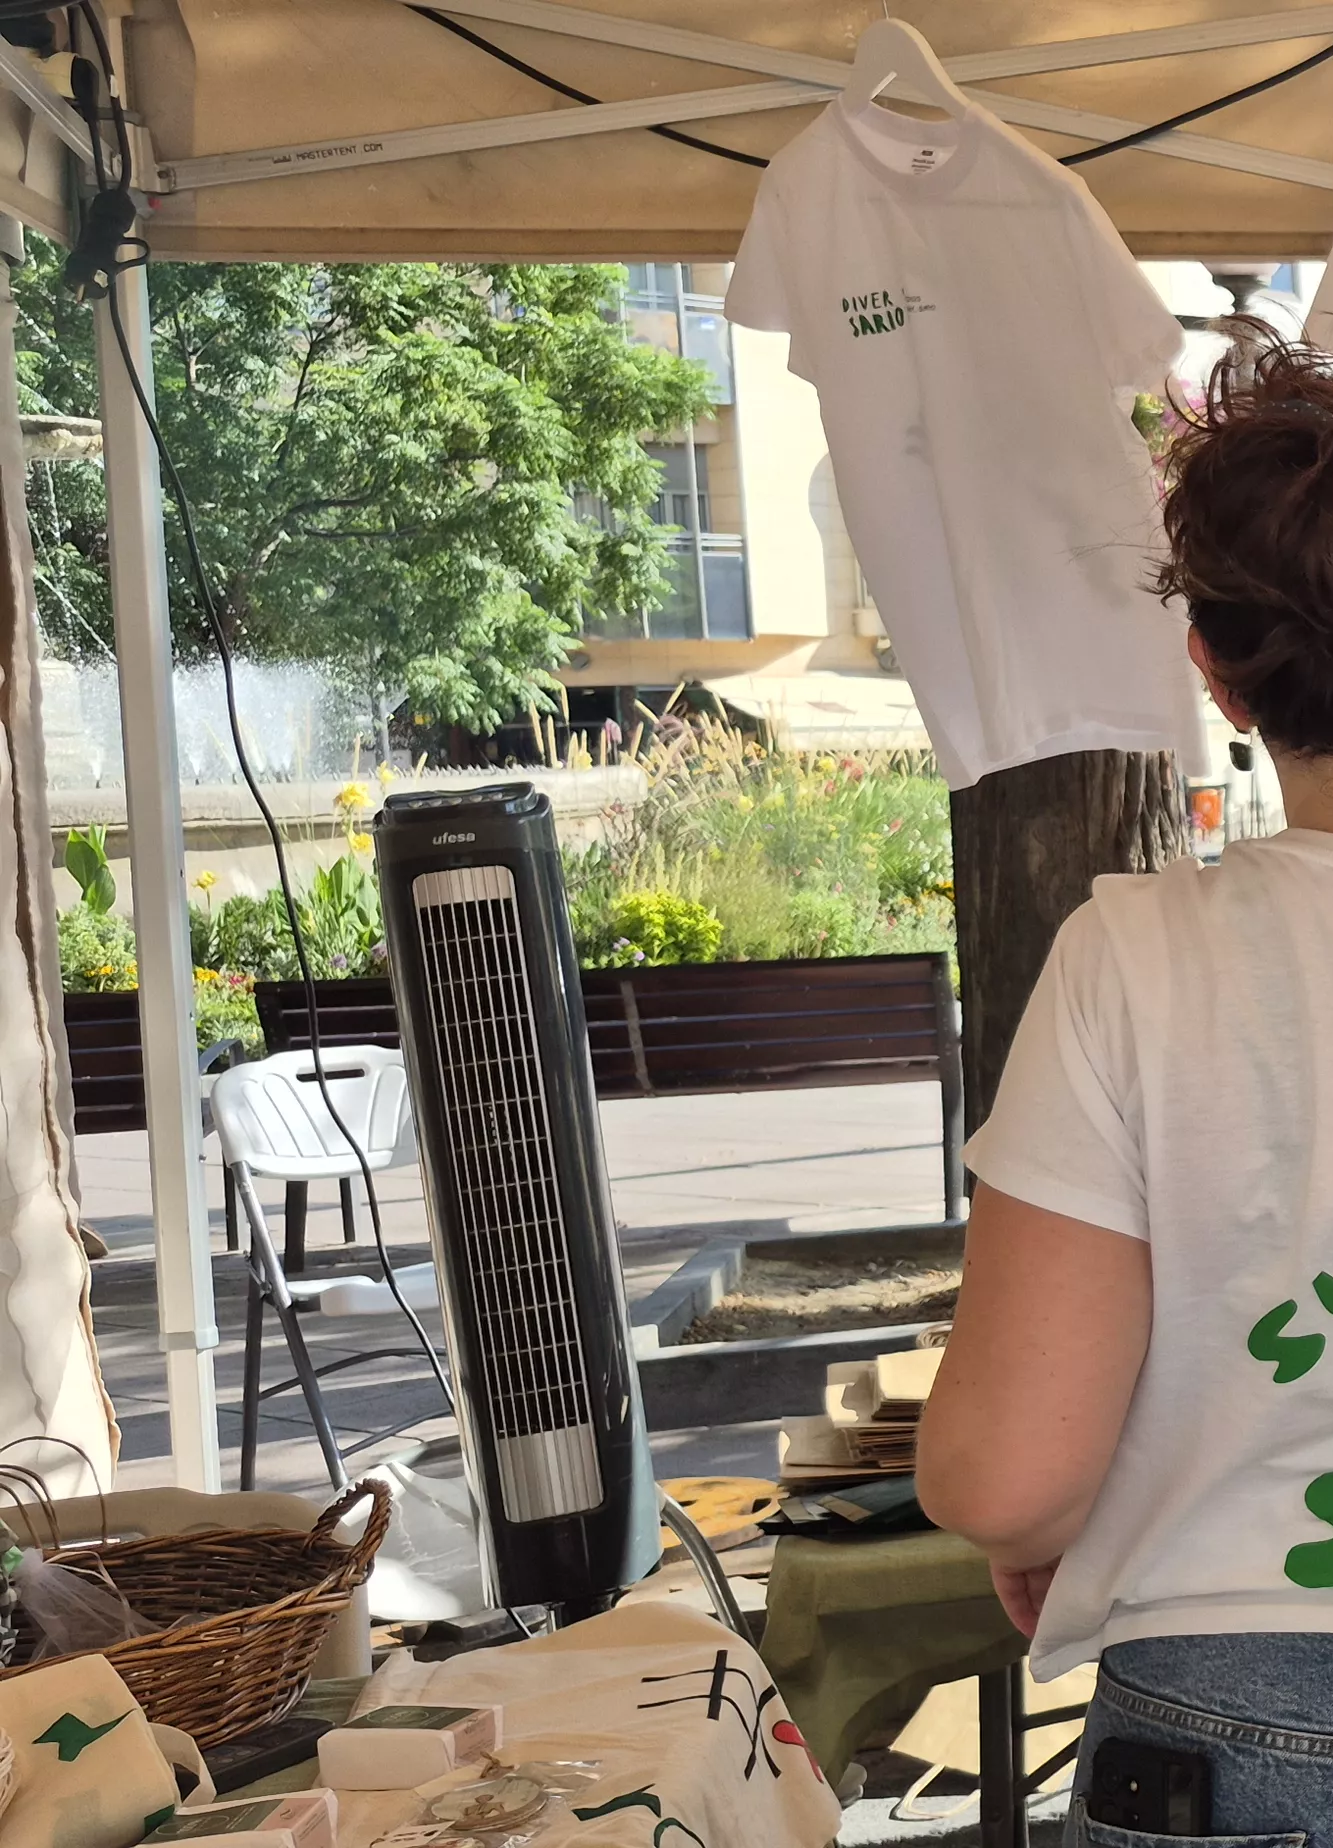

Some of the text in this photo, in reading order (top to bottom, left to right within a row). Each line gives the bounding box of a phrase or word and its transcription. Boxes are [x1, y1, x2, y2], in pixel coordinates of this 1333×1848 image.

[296, 146, 356, 160] MASTERTENT
[842, 290, 894, 313] DIVER
[849, 307, 905, 338] SARIO
[432, 832, 476, 845] ufesa
